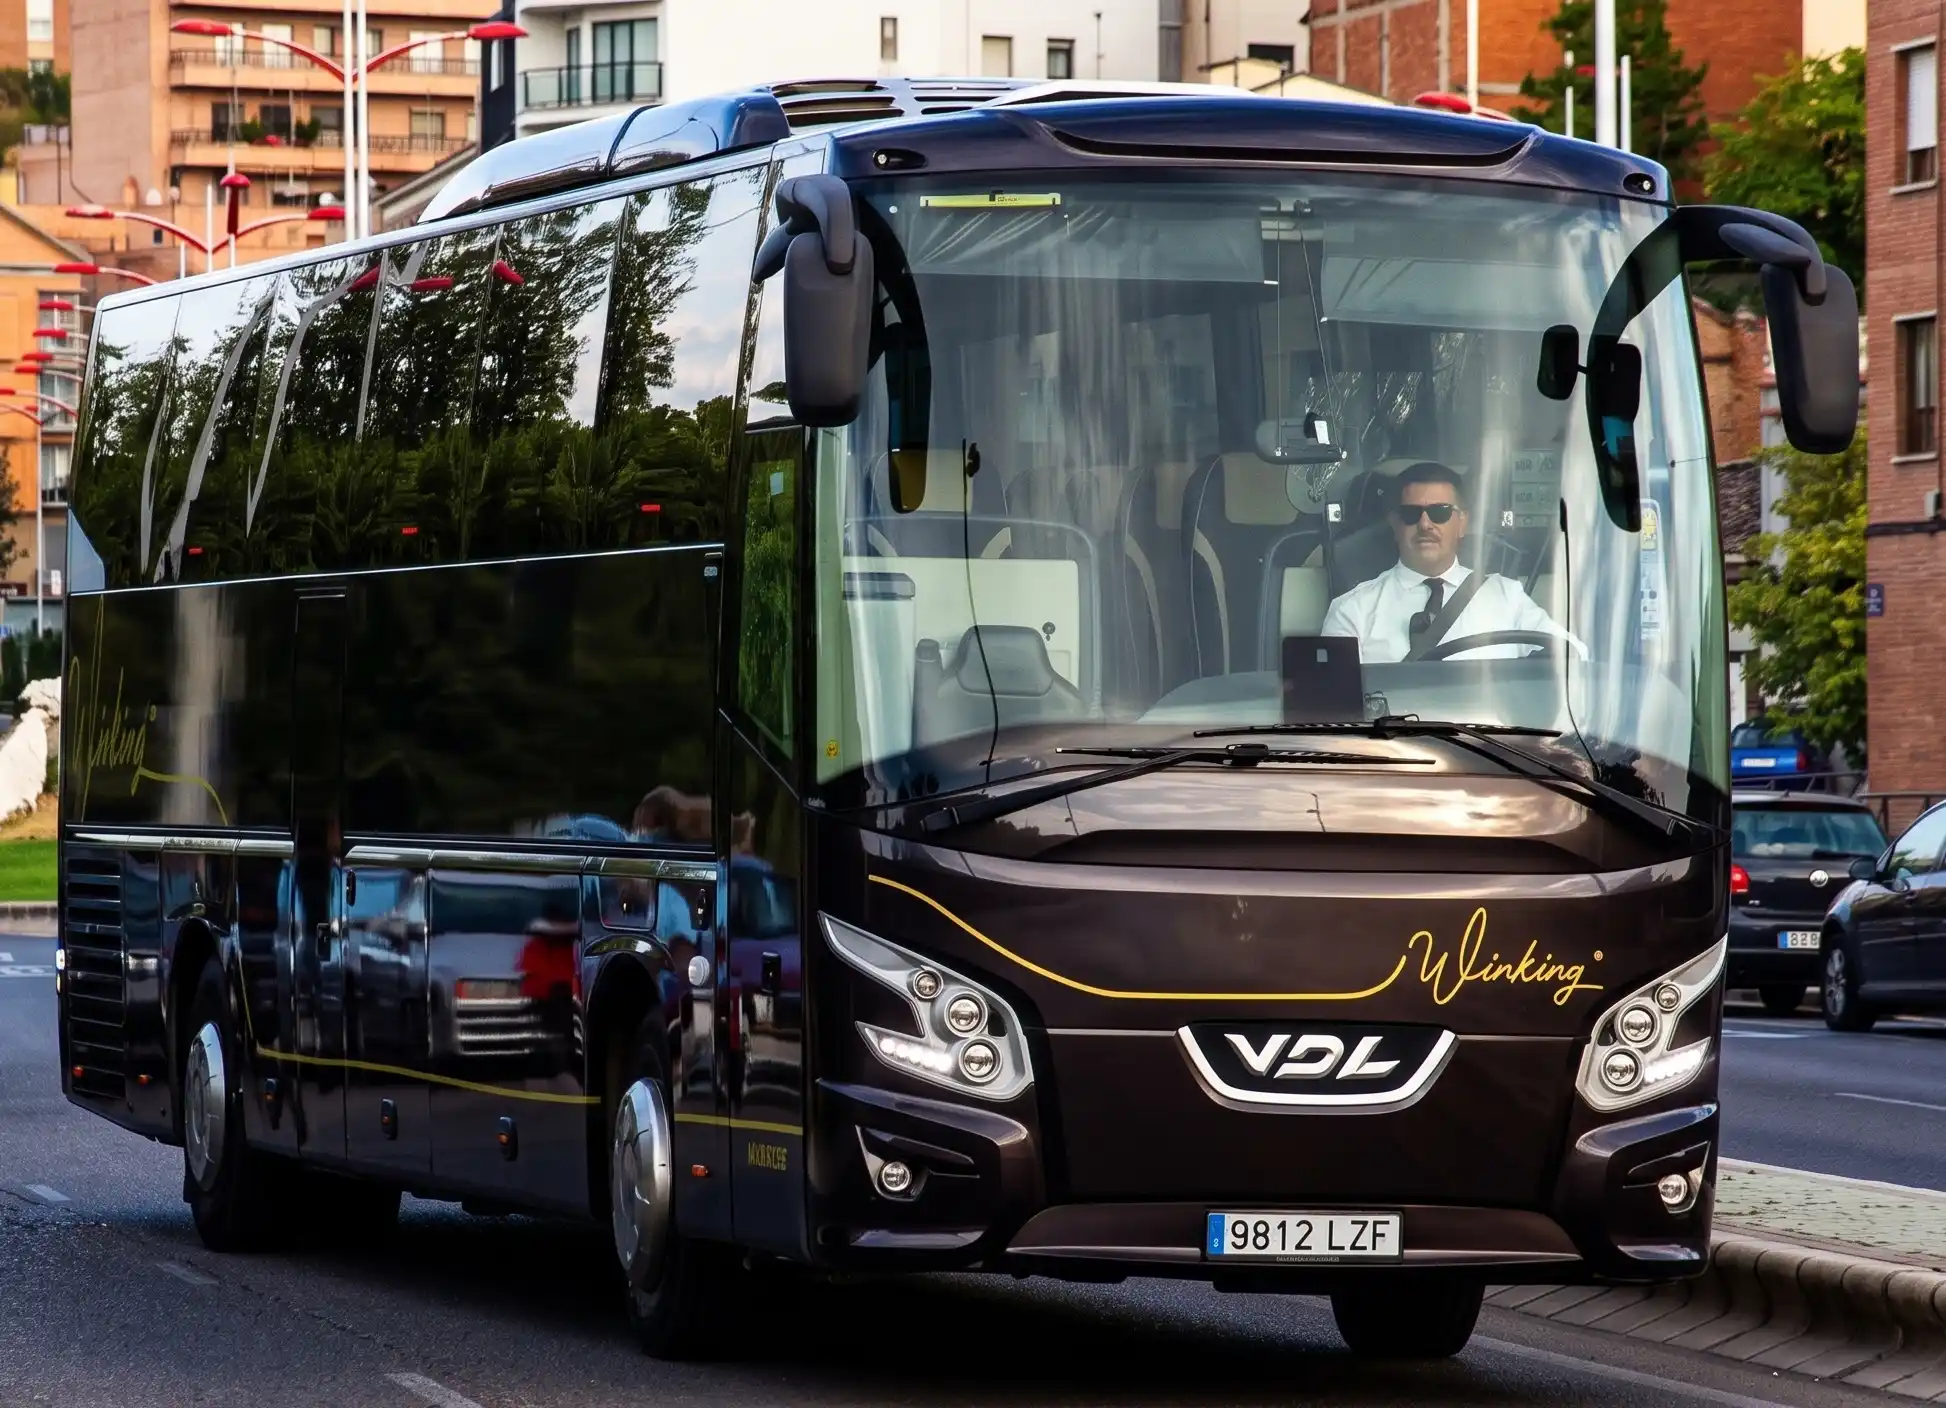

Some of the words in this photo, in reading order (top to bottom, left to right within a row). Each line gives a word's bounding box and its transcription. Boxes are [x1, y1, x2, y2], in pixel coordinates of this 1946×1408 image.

[1790, 933, 1821, 947] 828
[1224, 1033, 1401, 1080] VDL
[1231, 1219, 1314, 1251] 9812
[1328, 1220, 1390, 1251] LZF
